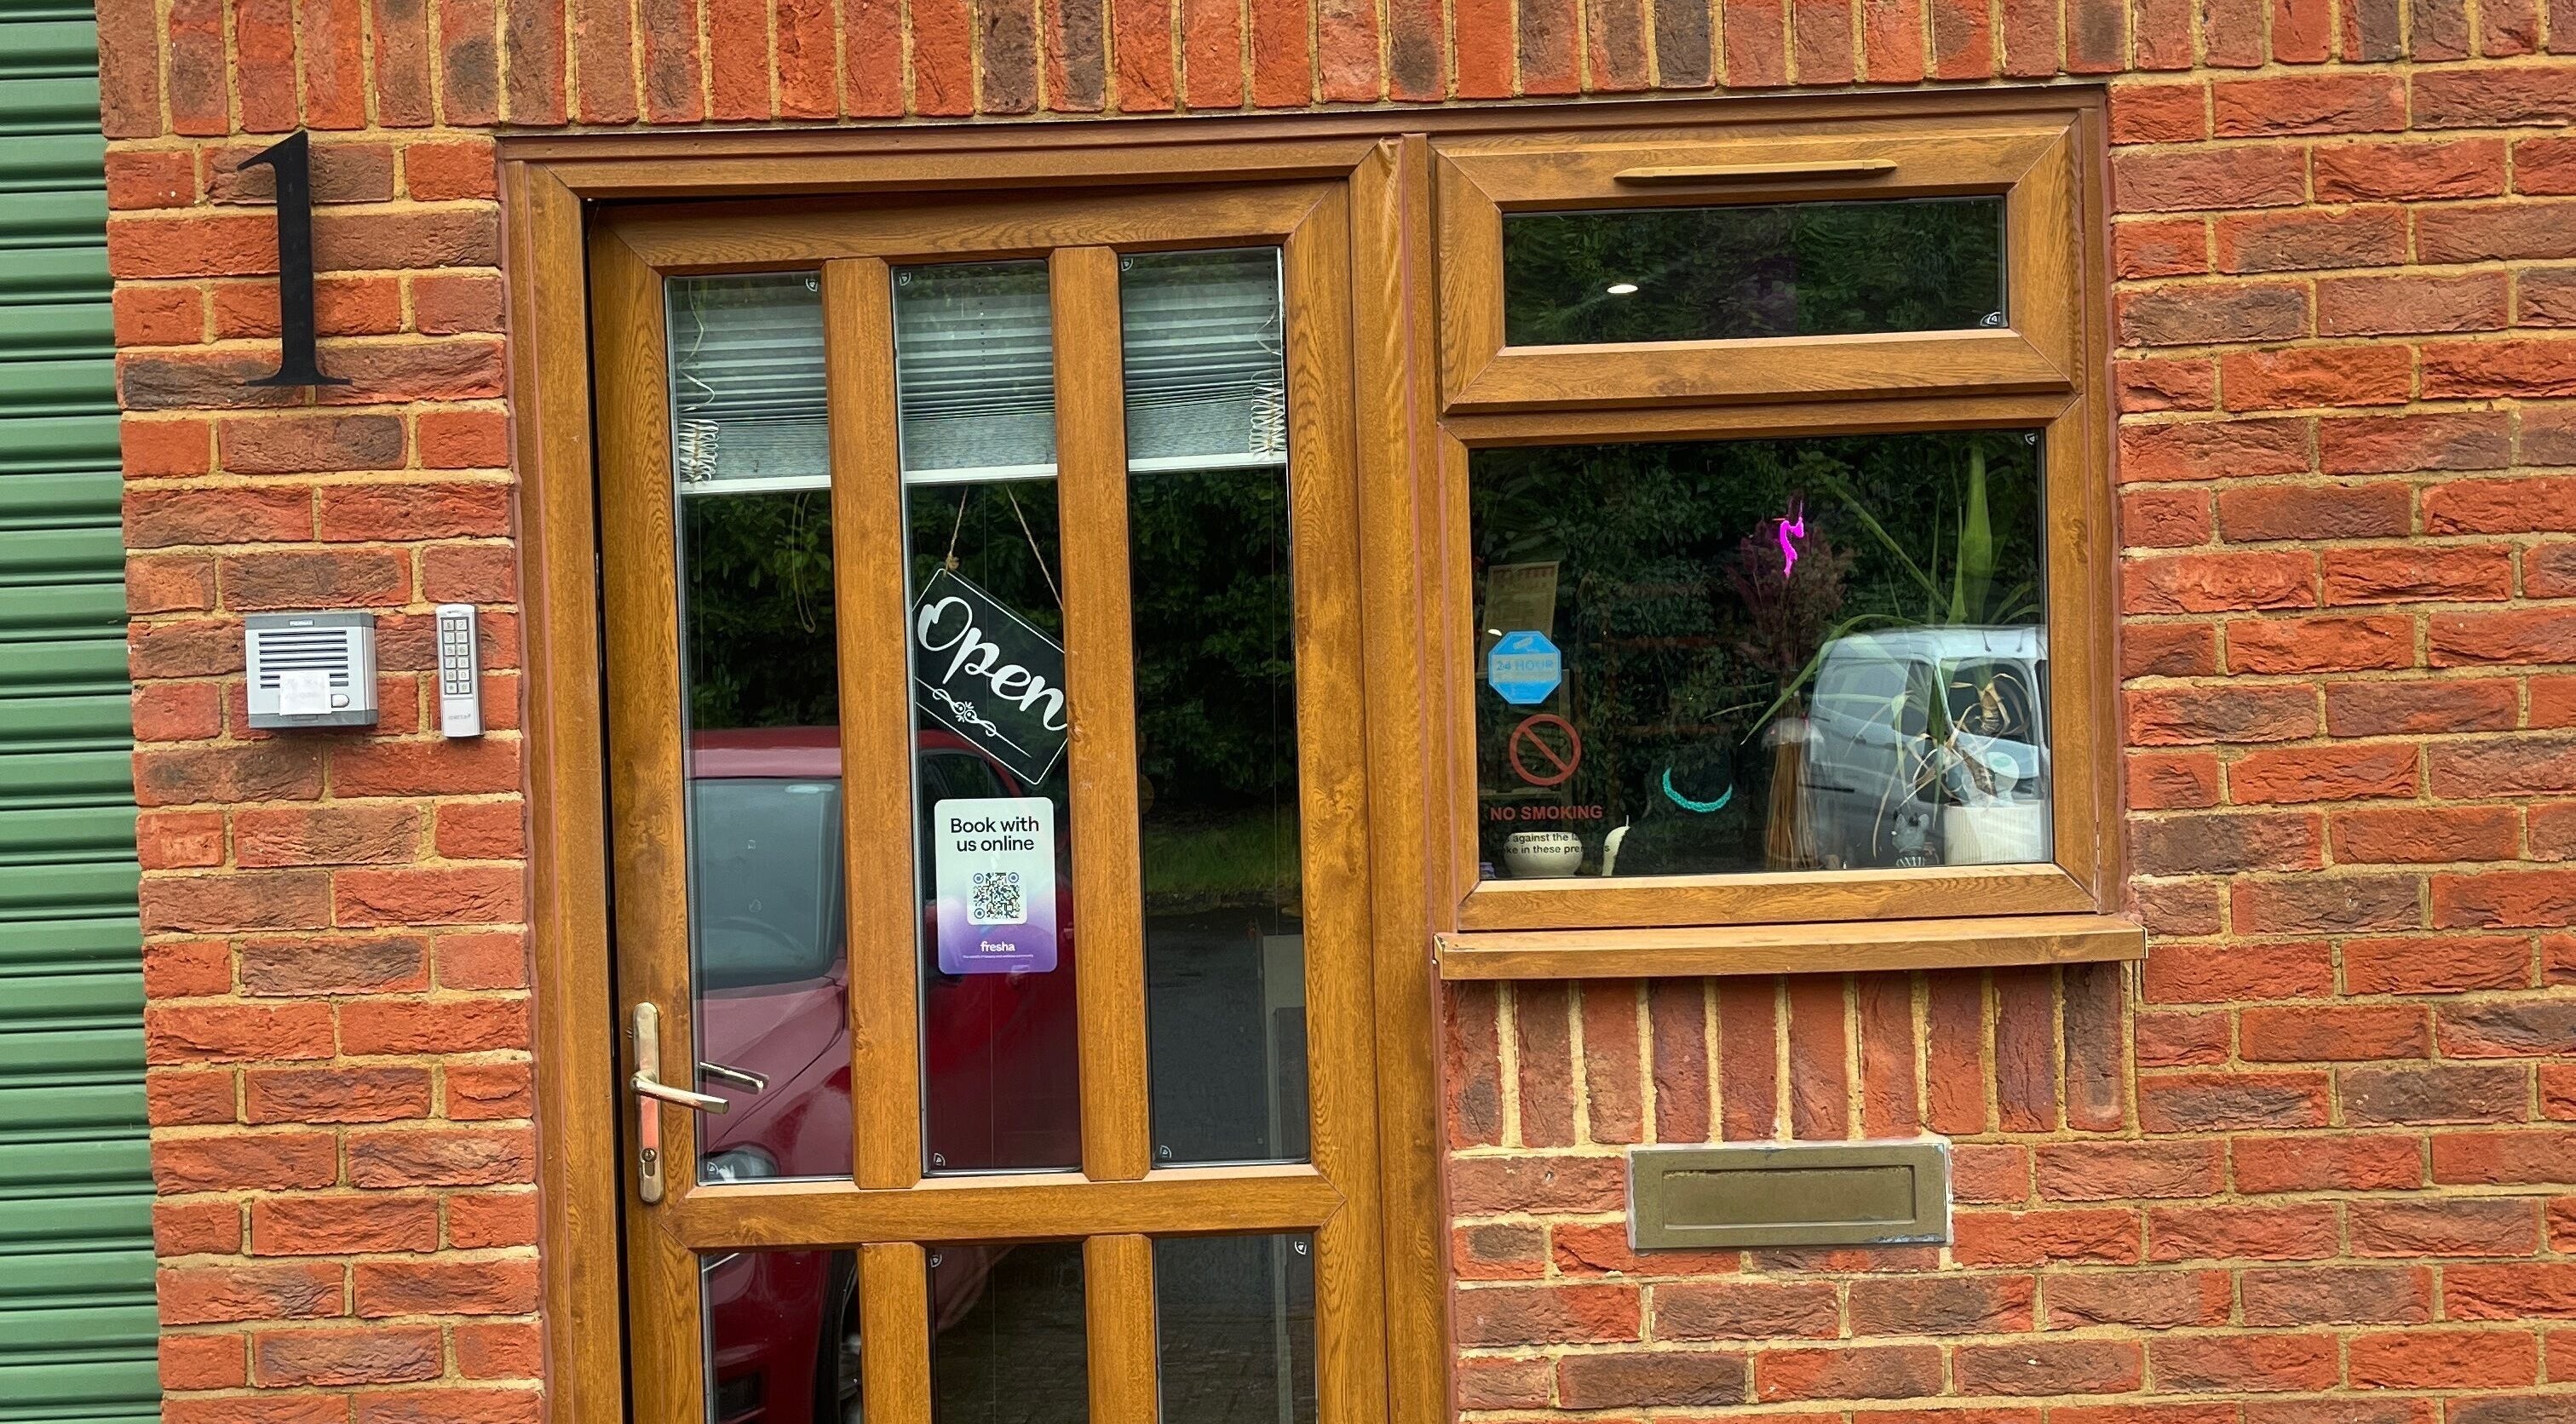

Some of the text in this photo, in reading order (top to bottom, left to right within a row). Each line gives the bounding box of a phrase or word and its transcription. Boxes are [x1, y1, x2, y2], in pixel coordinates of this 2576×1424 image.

[237, 129, 353, 386] 1
[917, 596, 1067, 731] Open
[1515, 659, 1554, 670] HOUR
[1490, 805, 1603, 821] NO SMOKING
[950, 816, 1039, 833] Book with
[957, 835, 1035, 852] us online
[1513, 833, 1550, 845] against
[1552, 833, 1569, 841] the
[1521, 846, 1530, 854] in
[1533, 845, 1561, 853] these
[980, 940, 1016, 952] fresha
